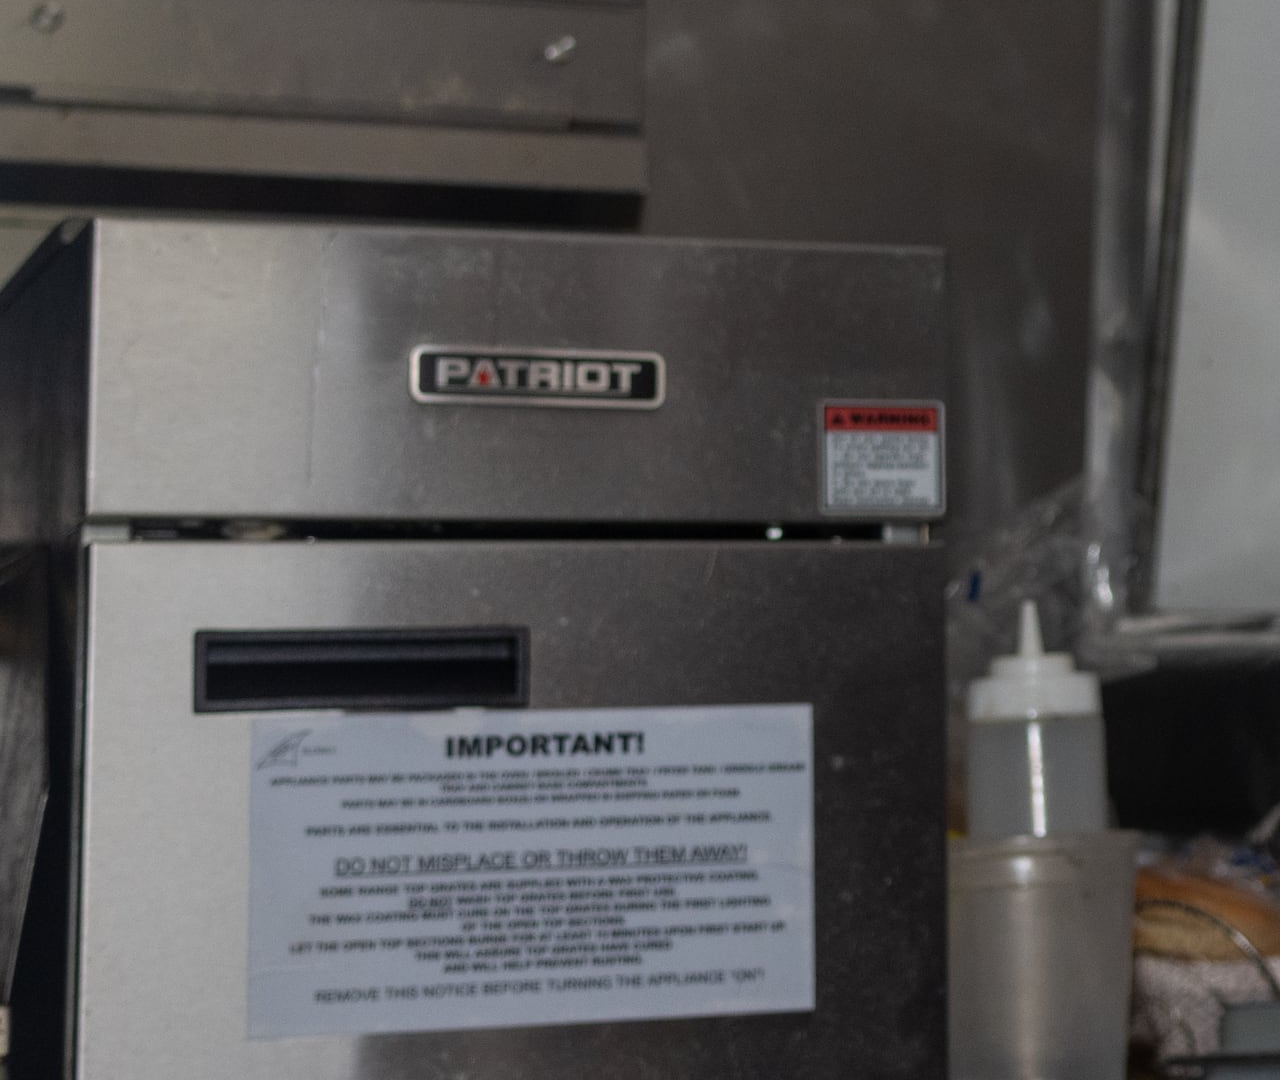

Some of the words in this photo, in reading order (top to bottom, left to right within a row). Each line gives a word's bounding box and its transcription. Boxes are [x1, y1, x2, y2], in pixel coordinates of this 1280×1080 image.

[436, 357, 642, 393] PATRIOT
[850, 413, 929, 424] WARNING
[446, 731, 645, 758] IMPORTANT!
[334, 856, 365, 876] DO
[370, 854, 410, 874] NOT
[416, 851, 512, 873] MISPLACE
[519, 850, 549, 870] OR
[556, 847, 628, 869] THROW
[634, 845, 686, 866] THEM
